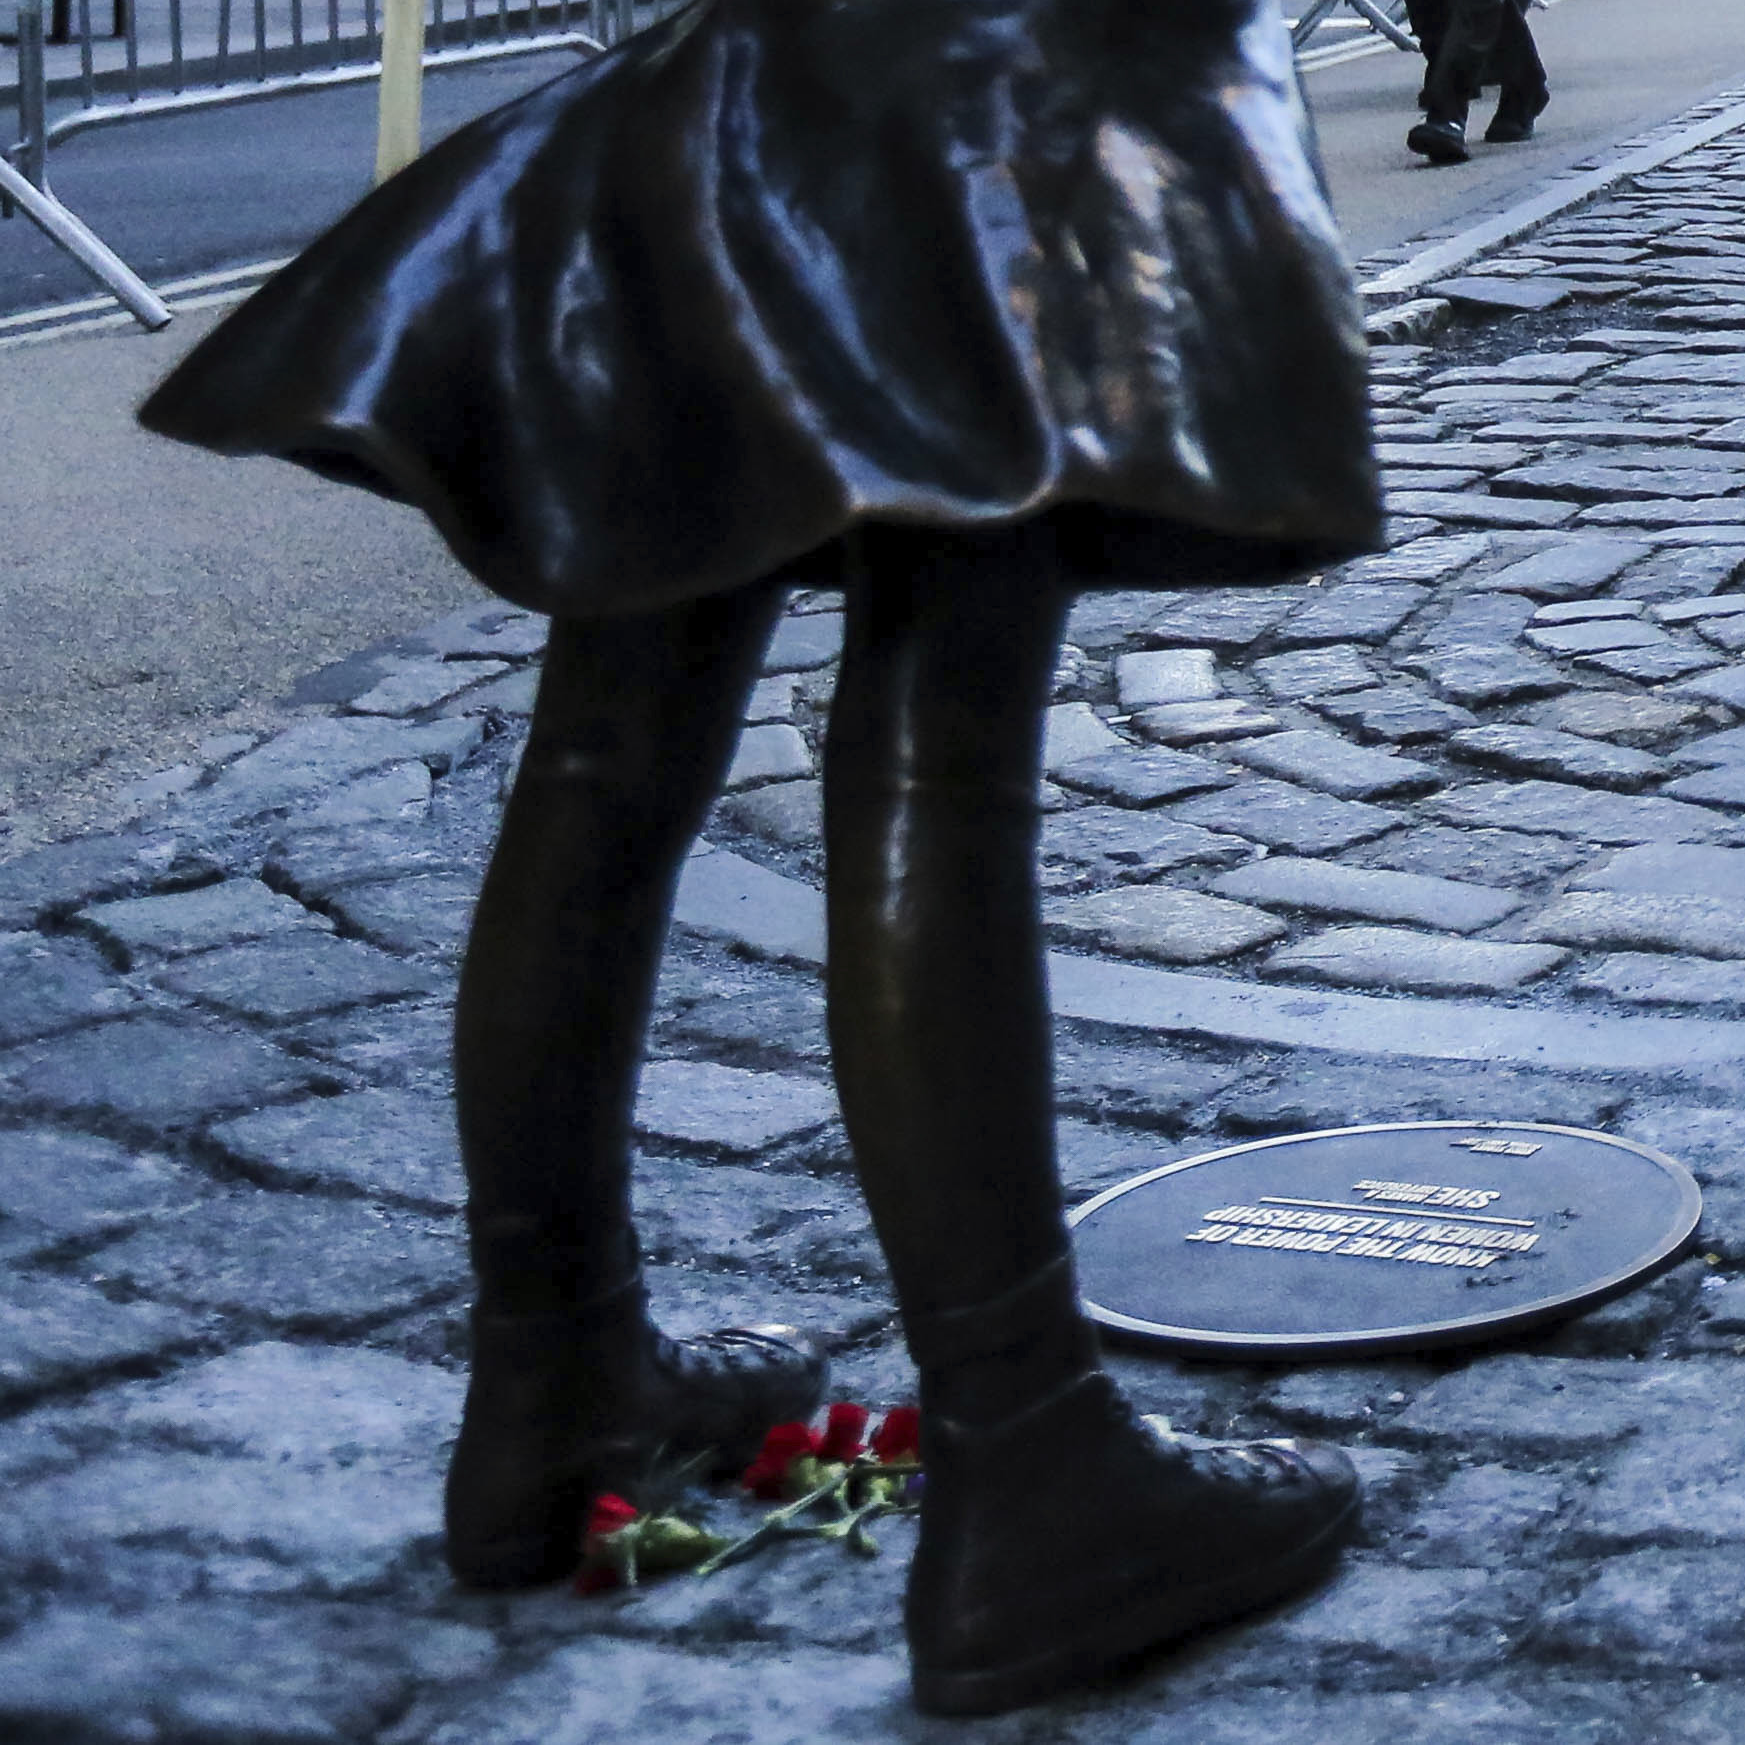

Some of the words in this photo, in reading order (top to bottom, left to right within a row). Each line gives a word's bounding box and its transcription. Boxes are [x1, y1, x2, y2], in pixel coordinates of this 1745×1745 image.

[1424, 1186, 1500, 1209] SHE
[1203, 1205, 1390, 1235] LEADERSHIP
[1381, 1220, 1426, 1239] IN
[1185, 1224, 1239, 1243] OF
[1231, 1228, 1348, 1252] POWER
[1417, 1225, 1540, 1252] WOMEN
[1336, 1236, 1405, 1259] THE
[1395, 1243, 1498, 1269] KNOW
